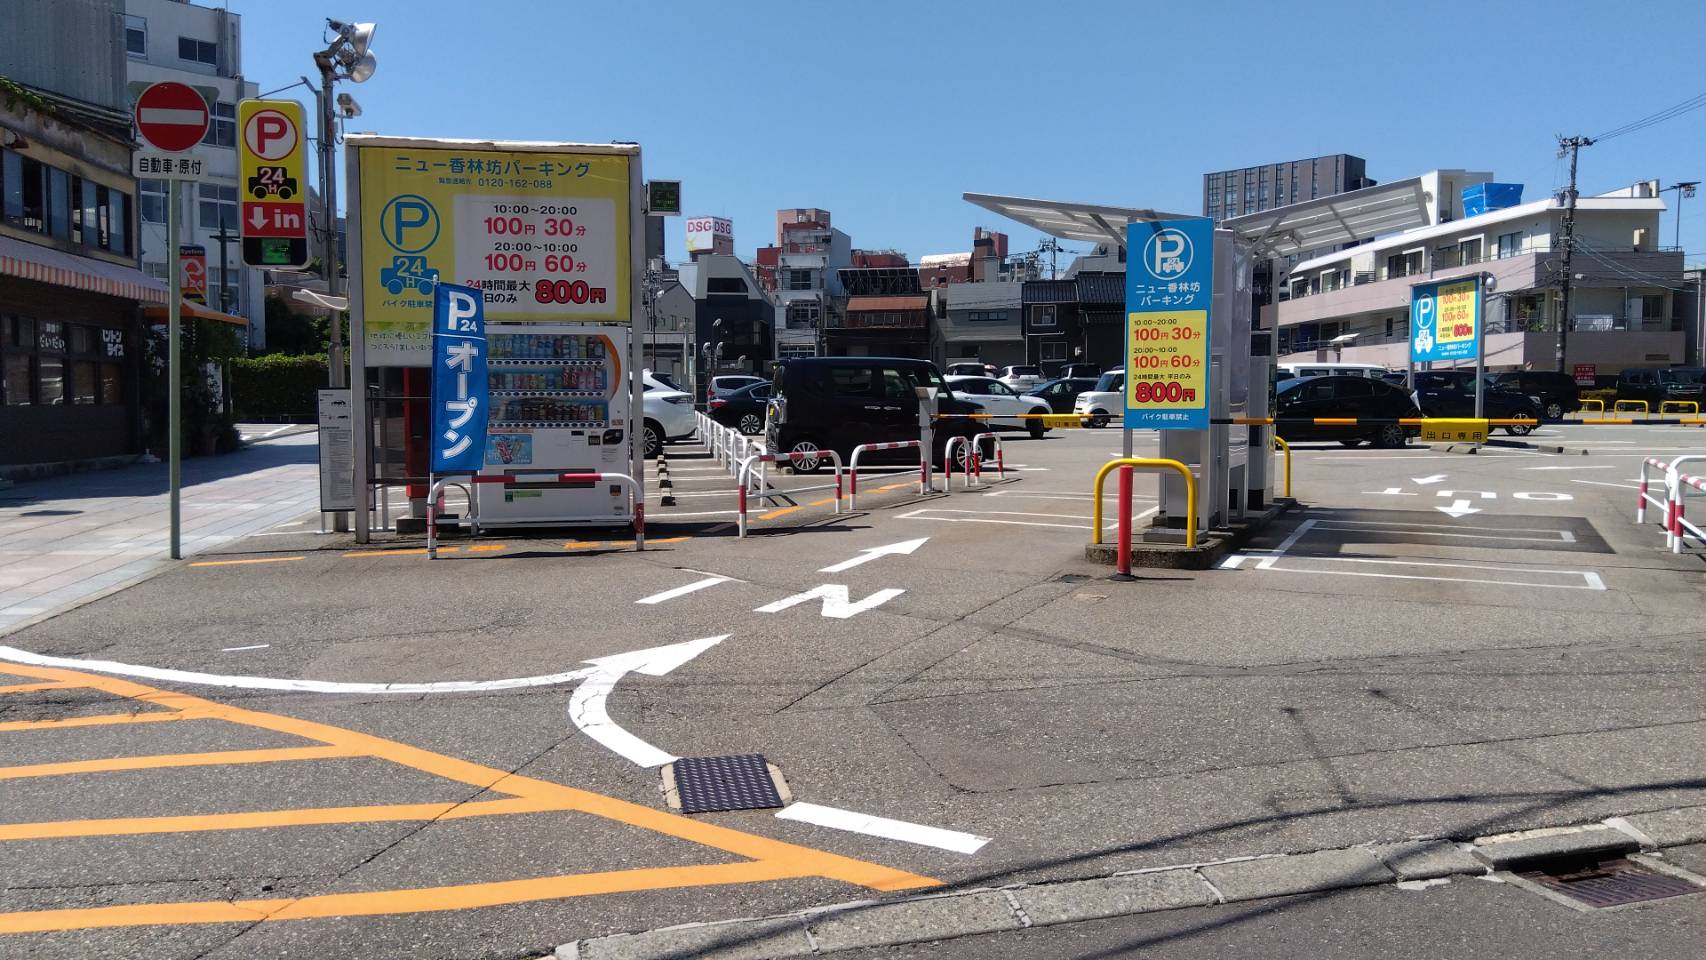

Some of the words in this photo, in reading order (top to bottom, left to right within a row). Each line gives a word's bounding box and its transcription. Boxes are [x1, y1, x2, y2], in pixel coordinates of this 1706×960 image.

[256, 116, 288, 154] P
[138, 157, 202, 175] 自動車・原付
[260, 168, 285, 184] 24
[395, 156, 590, 178] ニュー香林坊パーキング
[478, 178, 553, 189] 0120-162-088
[274, 208, 300, 229] in
[394, 200, 430, 246] P
[483, 216, 537, 236] 100円
[544, 218, 587, 237] 30分
[687, 221, 712, 233] DSG
[714, 221, 732, 235] DSG
[484, 253, 537, 272] 100円
[544, 255, 588, 273] 60分
[1154, 234, 1185, 274] P
[397, 258, 424, 277] 24
[534, 278, 607, 305] 800円
[1135, 281, 1201, 295] ニュー香林坊
[1140, 293, 1195, 306] パーキング
[1419, 298, 1432, 324] P
[1133, 327, 1169, 341] 100円
[1171, 326, 1201, 340] 30分
[1133, 355, 1169, 369] 100円
[1170, 354, 1201, 368] 60分
[442, 341, 479, 460] オープン
[1134, 381, 1196, 403] 800円
[1426, 431, 1483, 440] 出口専用
[634, 578, 907, 619] IN
